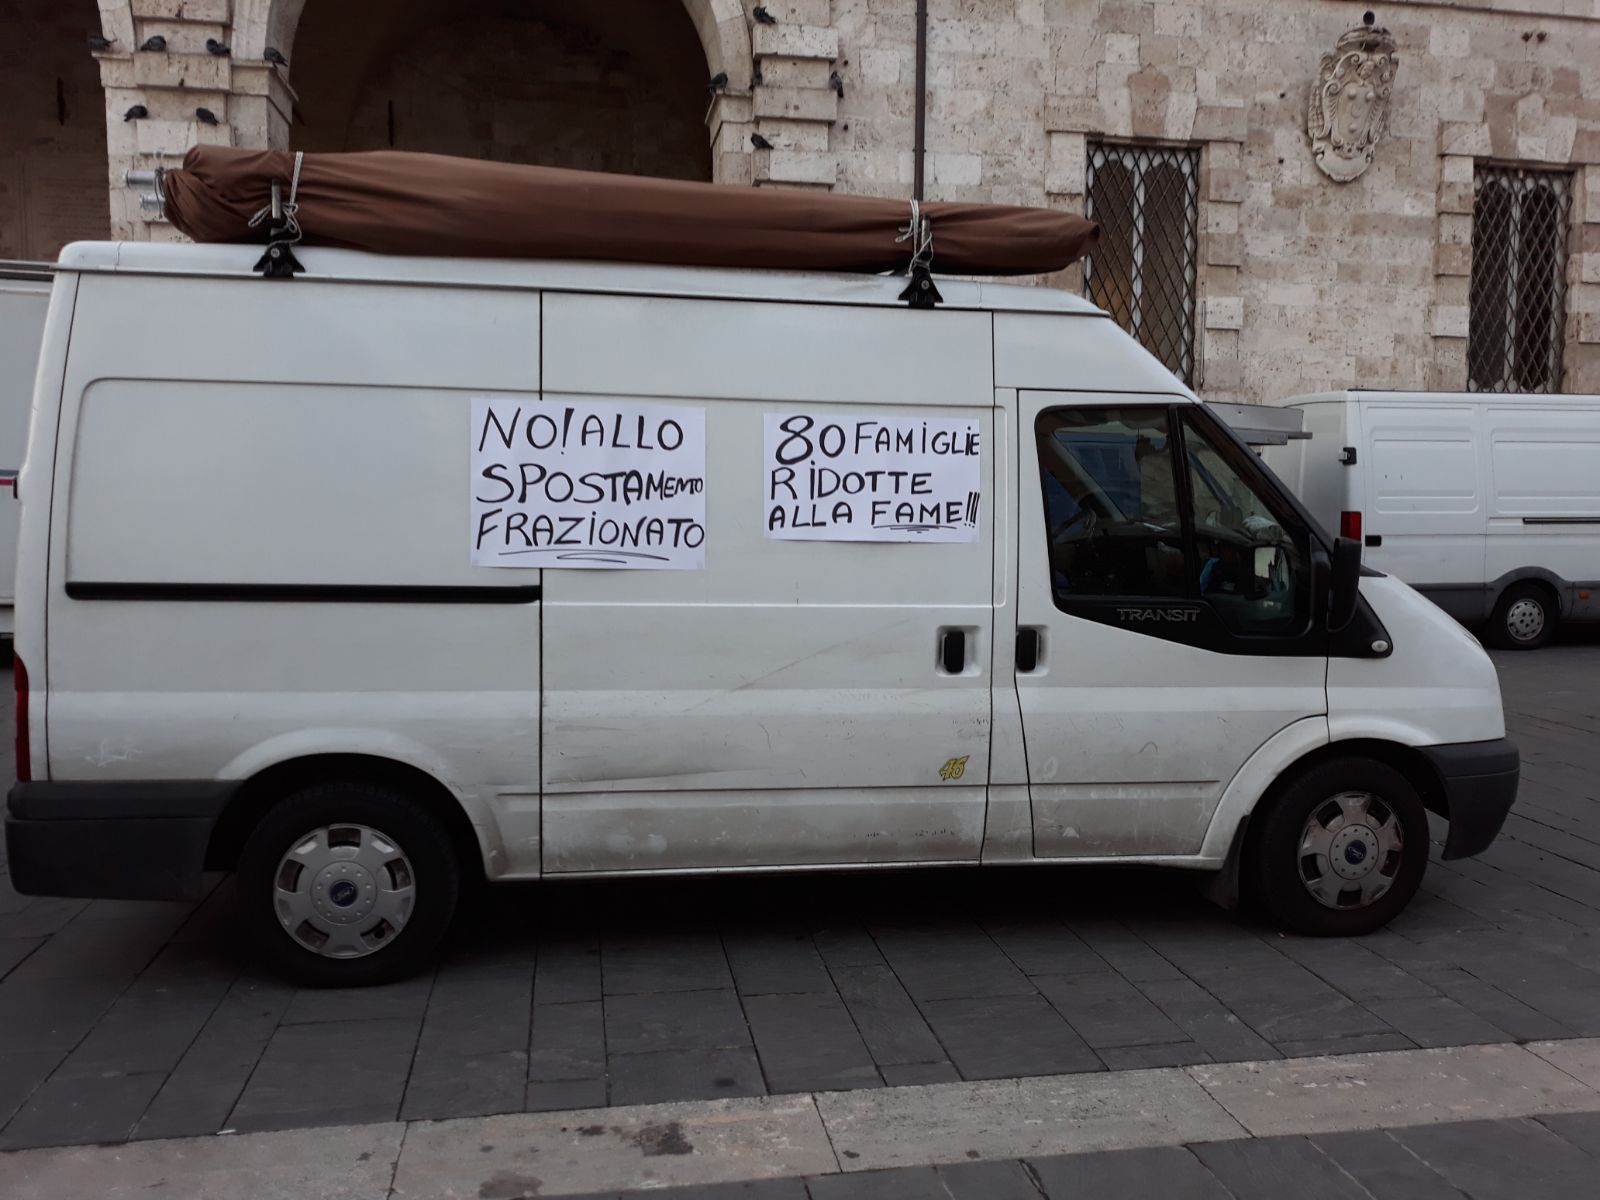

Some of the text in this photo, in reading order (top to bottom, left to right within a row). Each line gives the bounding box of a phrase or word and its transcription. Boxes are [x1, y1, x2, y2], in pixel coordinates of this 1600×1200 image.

[581, 413, 684, 451] ALLO
[775, 415, 846, 465] 80
[476, 463, 704, 505] SPOSTAMENTO
[768, 491, 980, 531] ALLA FAME!!!
[1116, 608, 1200, 622] TRANSIT
